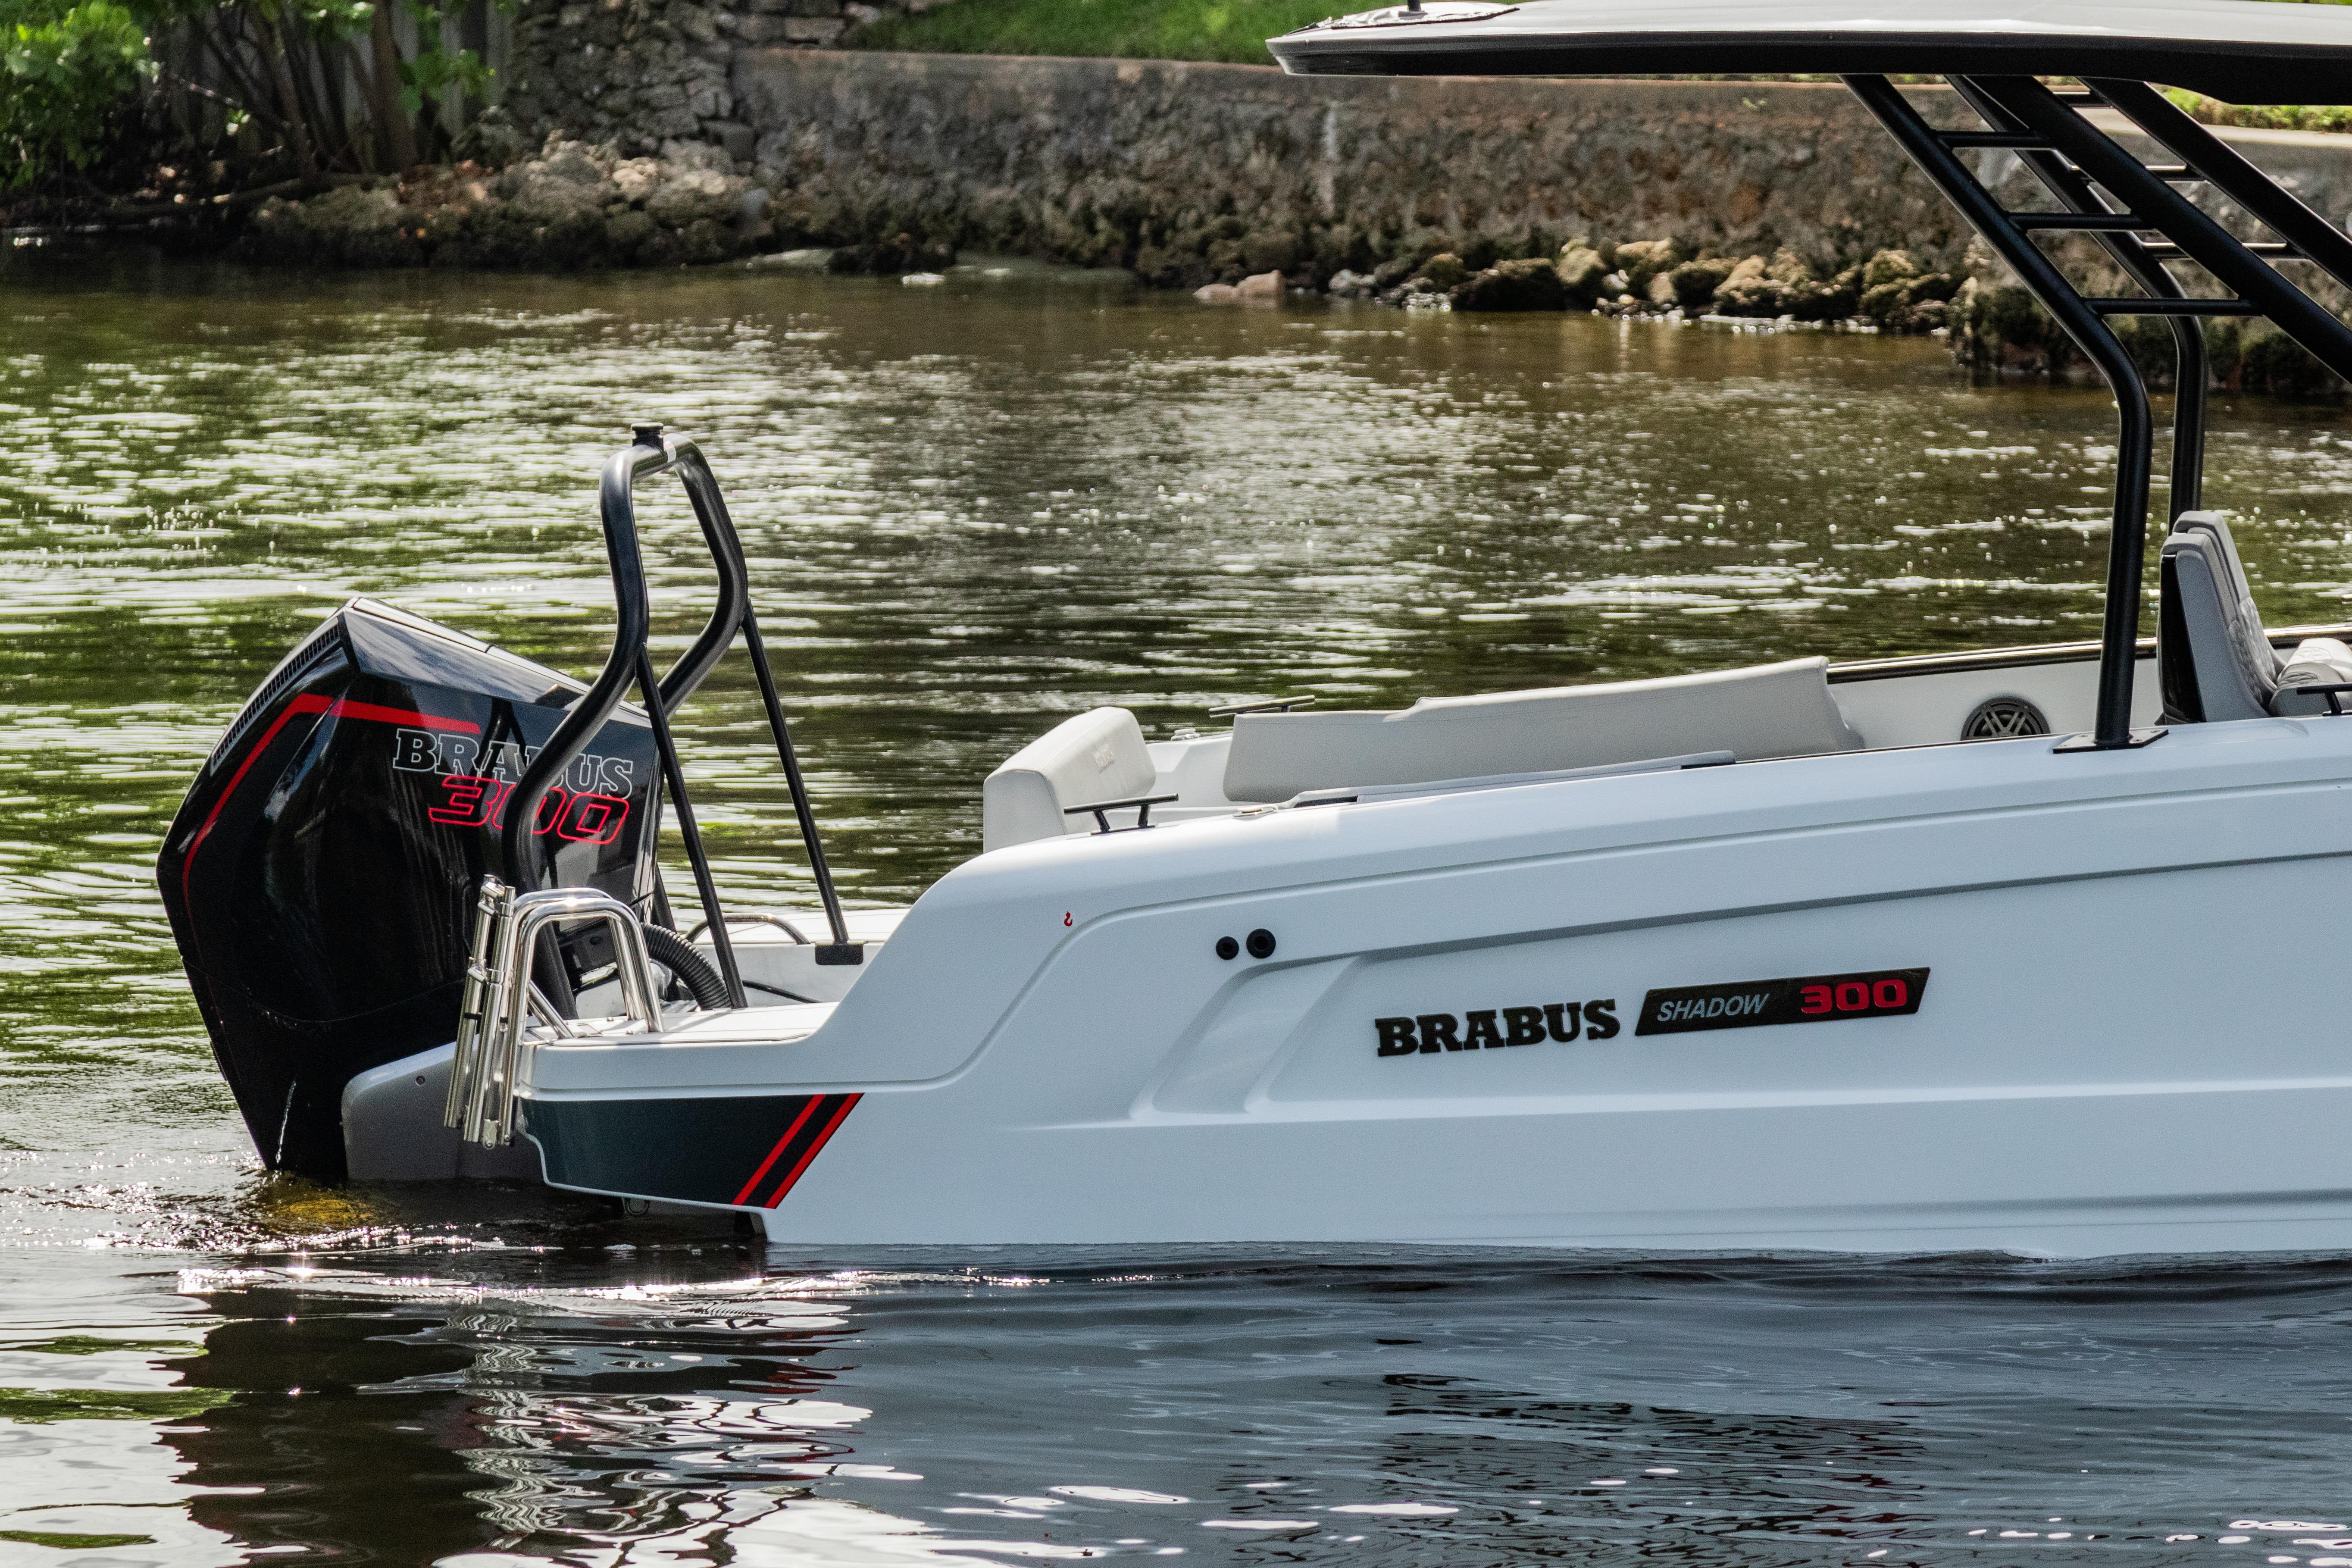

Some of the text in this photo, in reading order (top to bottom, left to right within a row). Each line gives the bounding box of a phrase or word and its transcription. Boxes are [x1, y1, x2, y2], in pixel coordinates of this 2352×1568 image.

[393, 729, 633, 800] BRAUS
[1375, 998, 1620, 1057] BRABUS
[1657, 980, 1907, 1022] SHADOW 300
